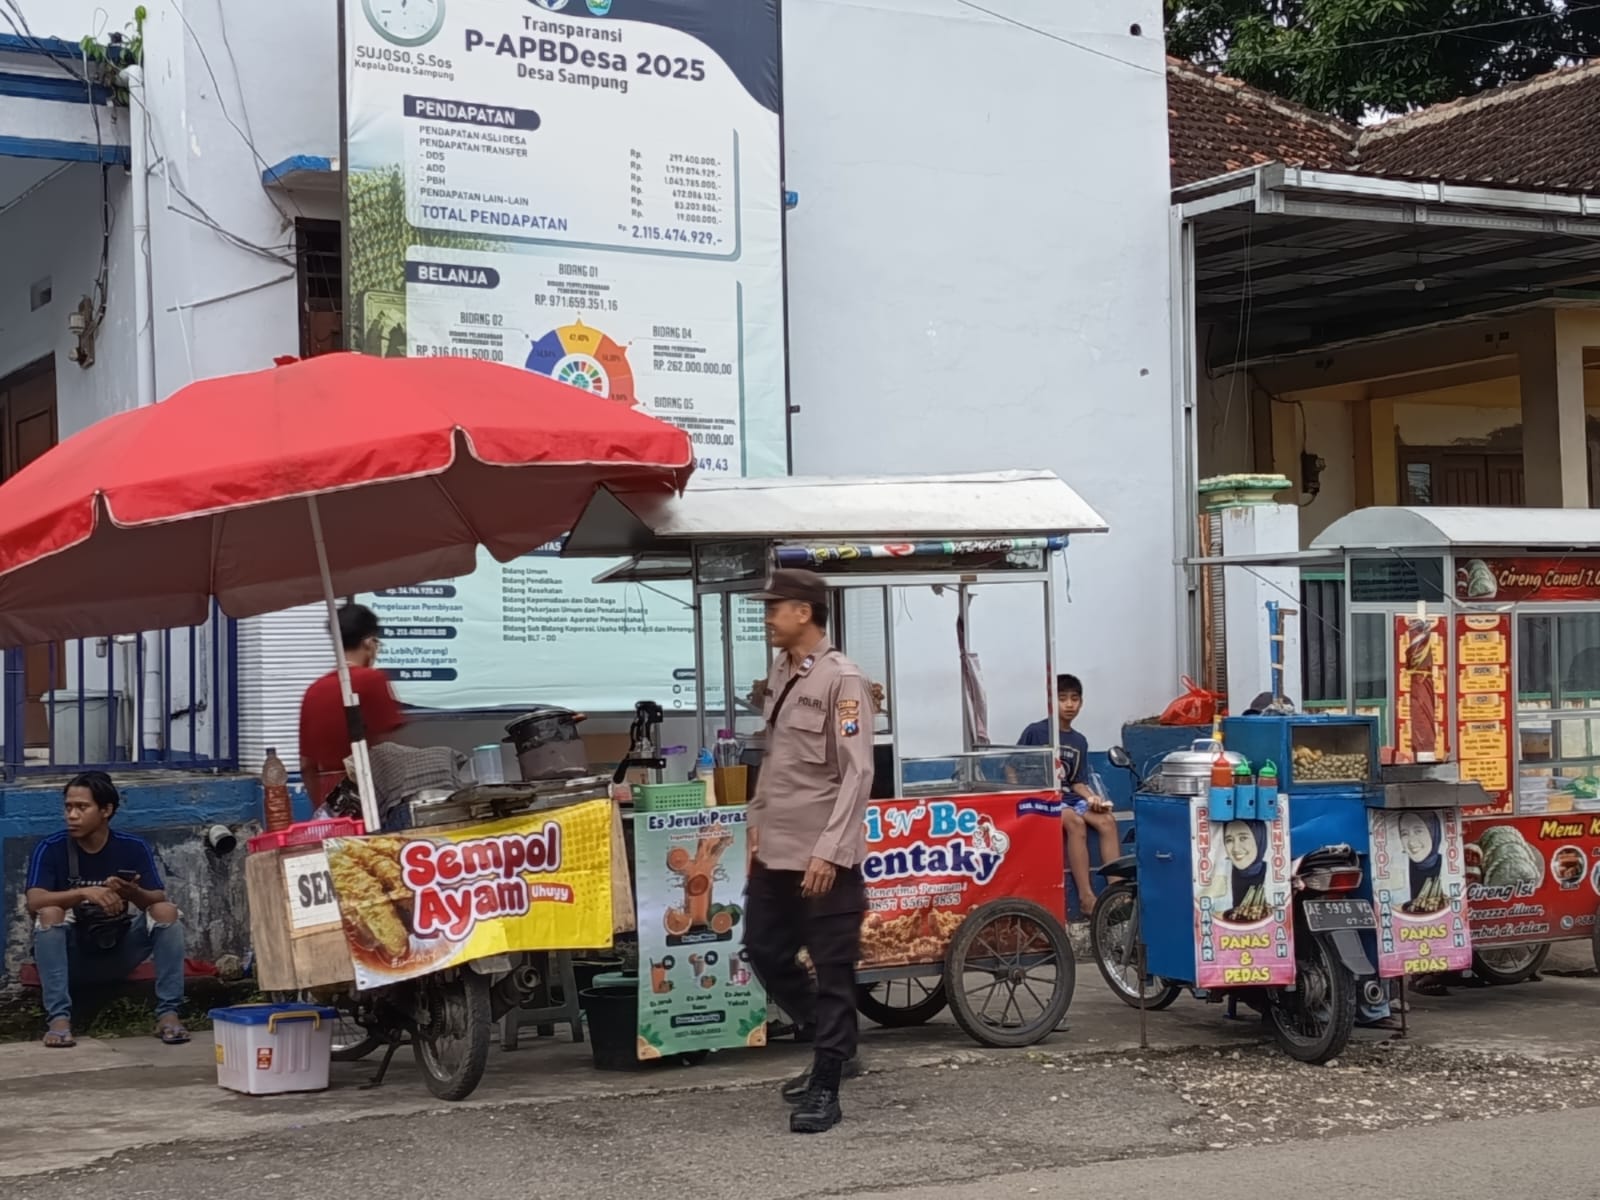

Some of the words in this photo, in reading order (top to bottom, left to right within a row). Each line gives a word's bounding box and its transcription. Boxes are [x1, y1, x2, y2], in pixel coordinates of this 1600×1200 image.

[522, 15, 623, 43] Transparansi
[416, 53, 452, 70] S.Sos
[465, 28, 628, 73] P-APBDesa
[635, 51, 706, 82] 2025
[354, 59, 386, 72] Kepala
[387, 63, 411, 75] Desa
[412, 66, 454, 81] Sampung
[516, 62, 555, 82] Desa
[558, 67, 629, 94] Sampung
[415, 100, 515, 126] PENDAPATAN
[419, 125, 480, 140] PENDAPATAN
[481, 133, 501, 143] ASLI
[502, 135, 527, 146] DESA
[419, 138, 480, 152] PENDAPATAN
[481, 145, 528, 158] TRANSFER
[426, 164, 445, 174] ADD
[420, 187, 480, 201] PENDAPATAN
[482, 194, 529, 206] LAIN-LAIN
[421, 205, 467, 222] TOTAL
[470, 209, 567, 231] PENDAPATAN
[417, 265, 489, 286] BELANJA
[558, 263, 587, 277] BIDANG
[589, 265, 598, 277] 01
[534, 293, 547, 306] RP.
[460, 312, 490, 326] BIDANG
[492, 314, 503, 327] 02
[652, 325, 680, 339] BIDANG
[682, 327, 692, 339] 04
[653, 359, 665, 371] RP.
[654, 396, 682, 410] BIDANG
[684, 397, 694, 410] 05
[534, 541, 562, 551] ITAS
[502, 567, 525, 576] Bidang
[1499, 566, 1542, 592] Cireng
[1545, 568, 1585, 587] Comel
[502, 577, 525, 585] Bidang
[502, 596, 525, 604] Bidang
[502, 606, 526, 614] Bidang
[527, 606, 560, 614] Pekerjaan
[503, 615, 526, 623] Bidang
[503, 625, 526, 633] Bidang
[541, 625, 564, 633] Bidang
[667, 626, 694, 634] Menenga
[503, 634, 526, 643] Bidang
[377, 657, 419, 665] embiayaan
[798, 696, 823, 710] POLRI
[648, 815, 665, 829] Es
[667, 813, 707, 828] Jeruk
[710, 811, 748, 825] Peras
[929, 802, 978, 836] Be
[1540, 820, 1583, 838] Menu
[1197, 806, 1212, 887] PENTOL
[1445, 808, 1460, 875] ENTOL
[403, 822, 561, 888] Sempol
[863, 841, 1001, 882] entaky
[531, 884, 569, 901] Uhuyy
[1467, 884, 1513, 901] Cireng
[1515, 880, 1535, 896] Isi
[416, 878, 527, 939] Ayam
[1307, 902, 1321, 915] AE
[1450, 883, 1465, 948] KUAH
[1201, 896, 1214, 961] BAKAR
[1273, 892, 1287, 958] KUAH
[1379, 889, 1395, 953] BAKAR
[1400, 924, 1447, 942] PANAS
[1470, 925, 1499, 938] mbut
[1515, 922, 1550, 935] dalam
[1220, 935, 1270, 950] PANAS
[1418, 942, 1430, 956] &
[1240, 952, 1252, 966] &
[1404, 957, 1448, 974] PEDAS
[1224, 967, 1271, 984] PEDAS
